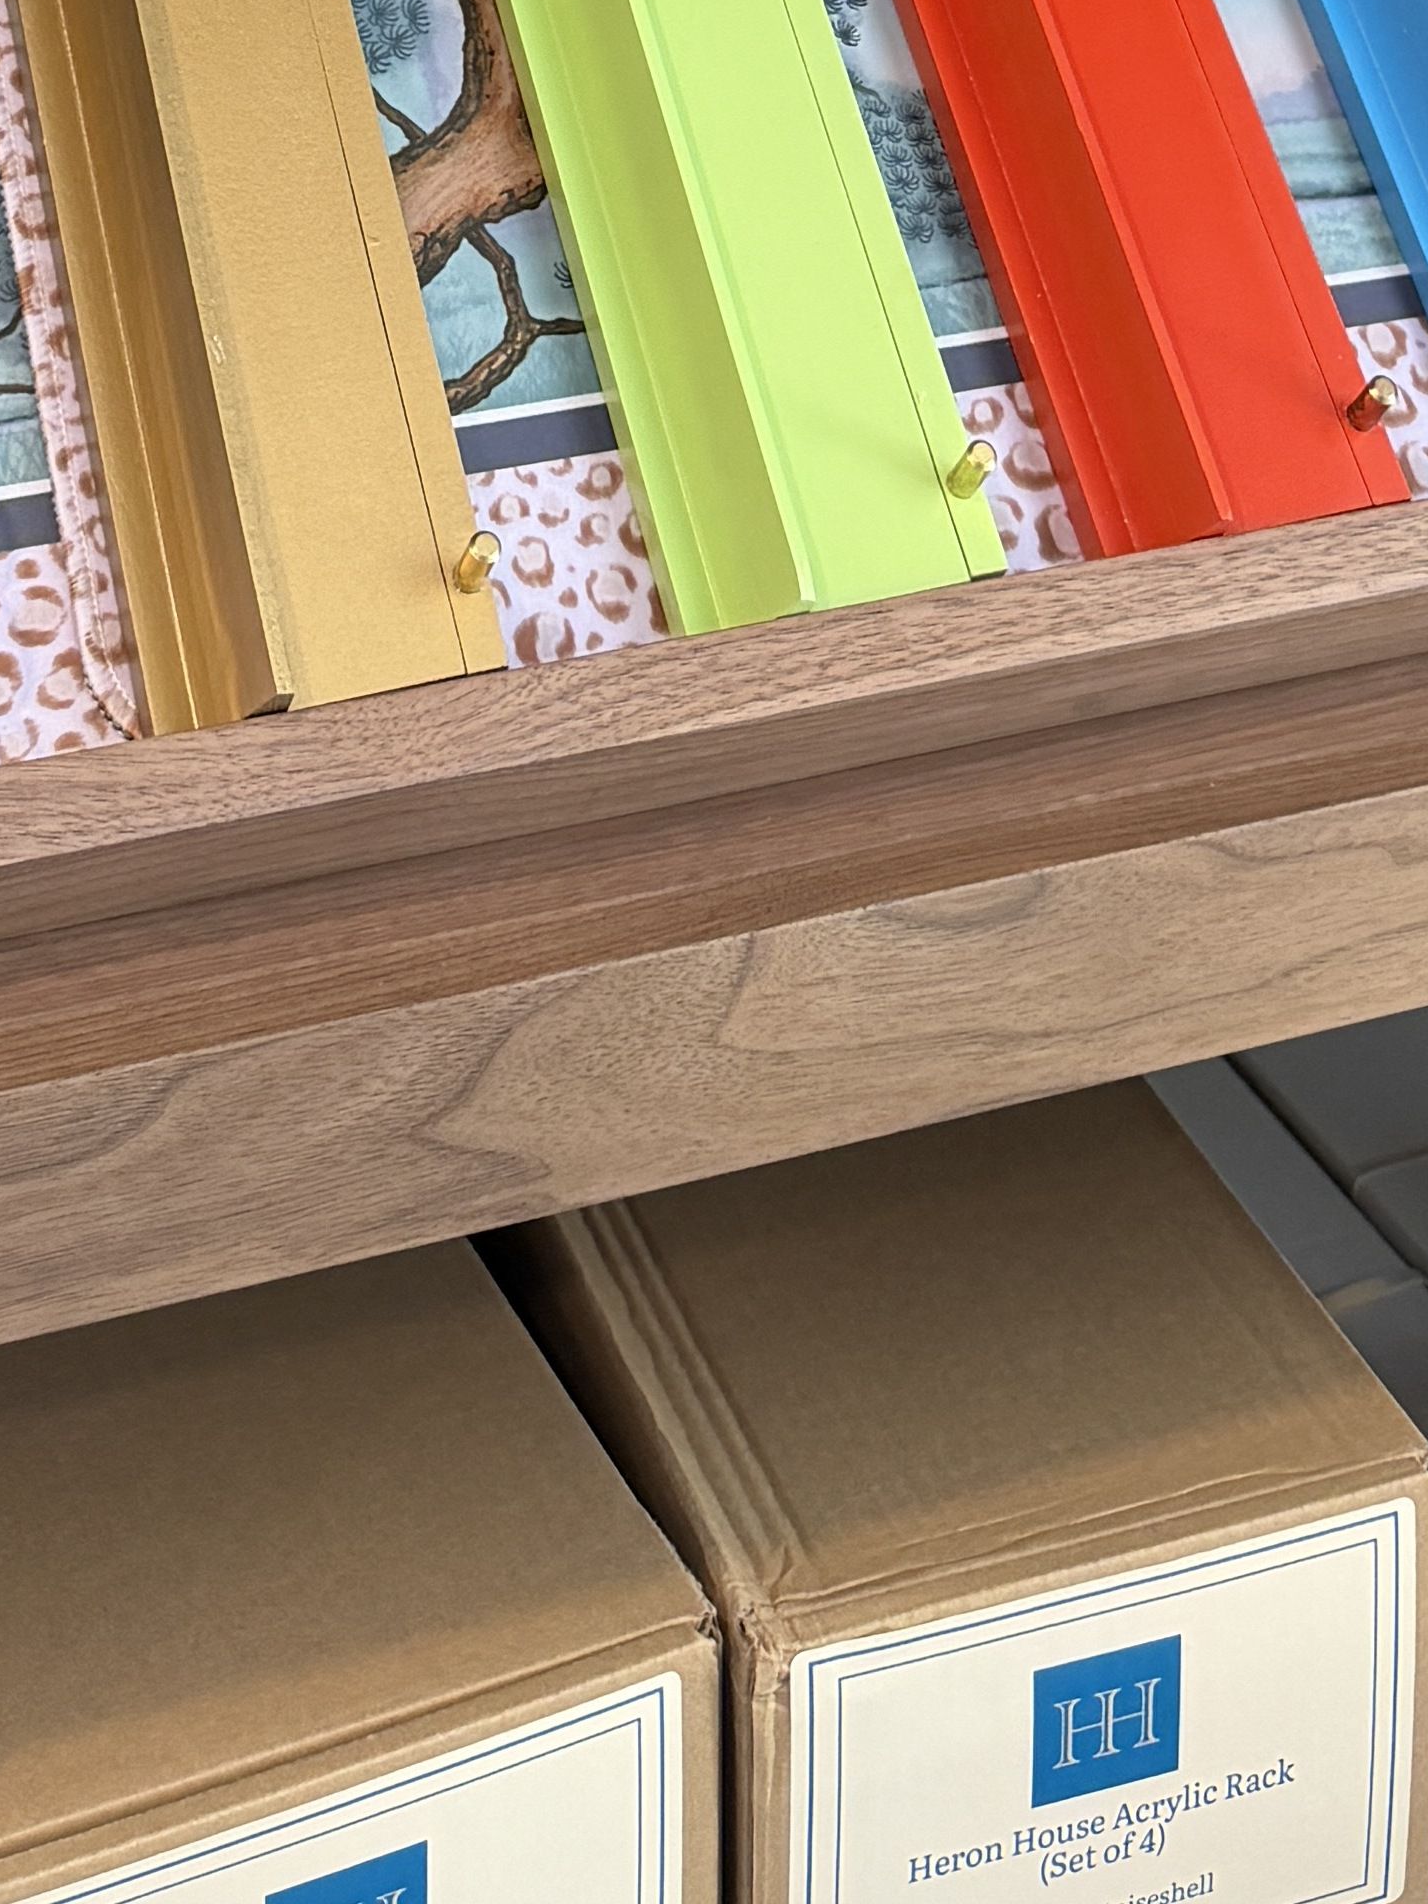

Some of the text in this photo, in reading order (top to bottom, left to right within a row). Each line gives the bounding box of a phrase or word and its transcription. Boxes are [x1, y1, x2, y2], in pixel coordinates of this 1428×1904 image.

[907, 1757, 1296, 1885] Heron House Acrylic Rack
[1040, 1851, 1097, 1888] (Set
[1102, 1831, 1136, 1866] of
[1138, 1822, 1167, 1858] 4)
